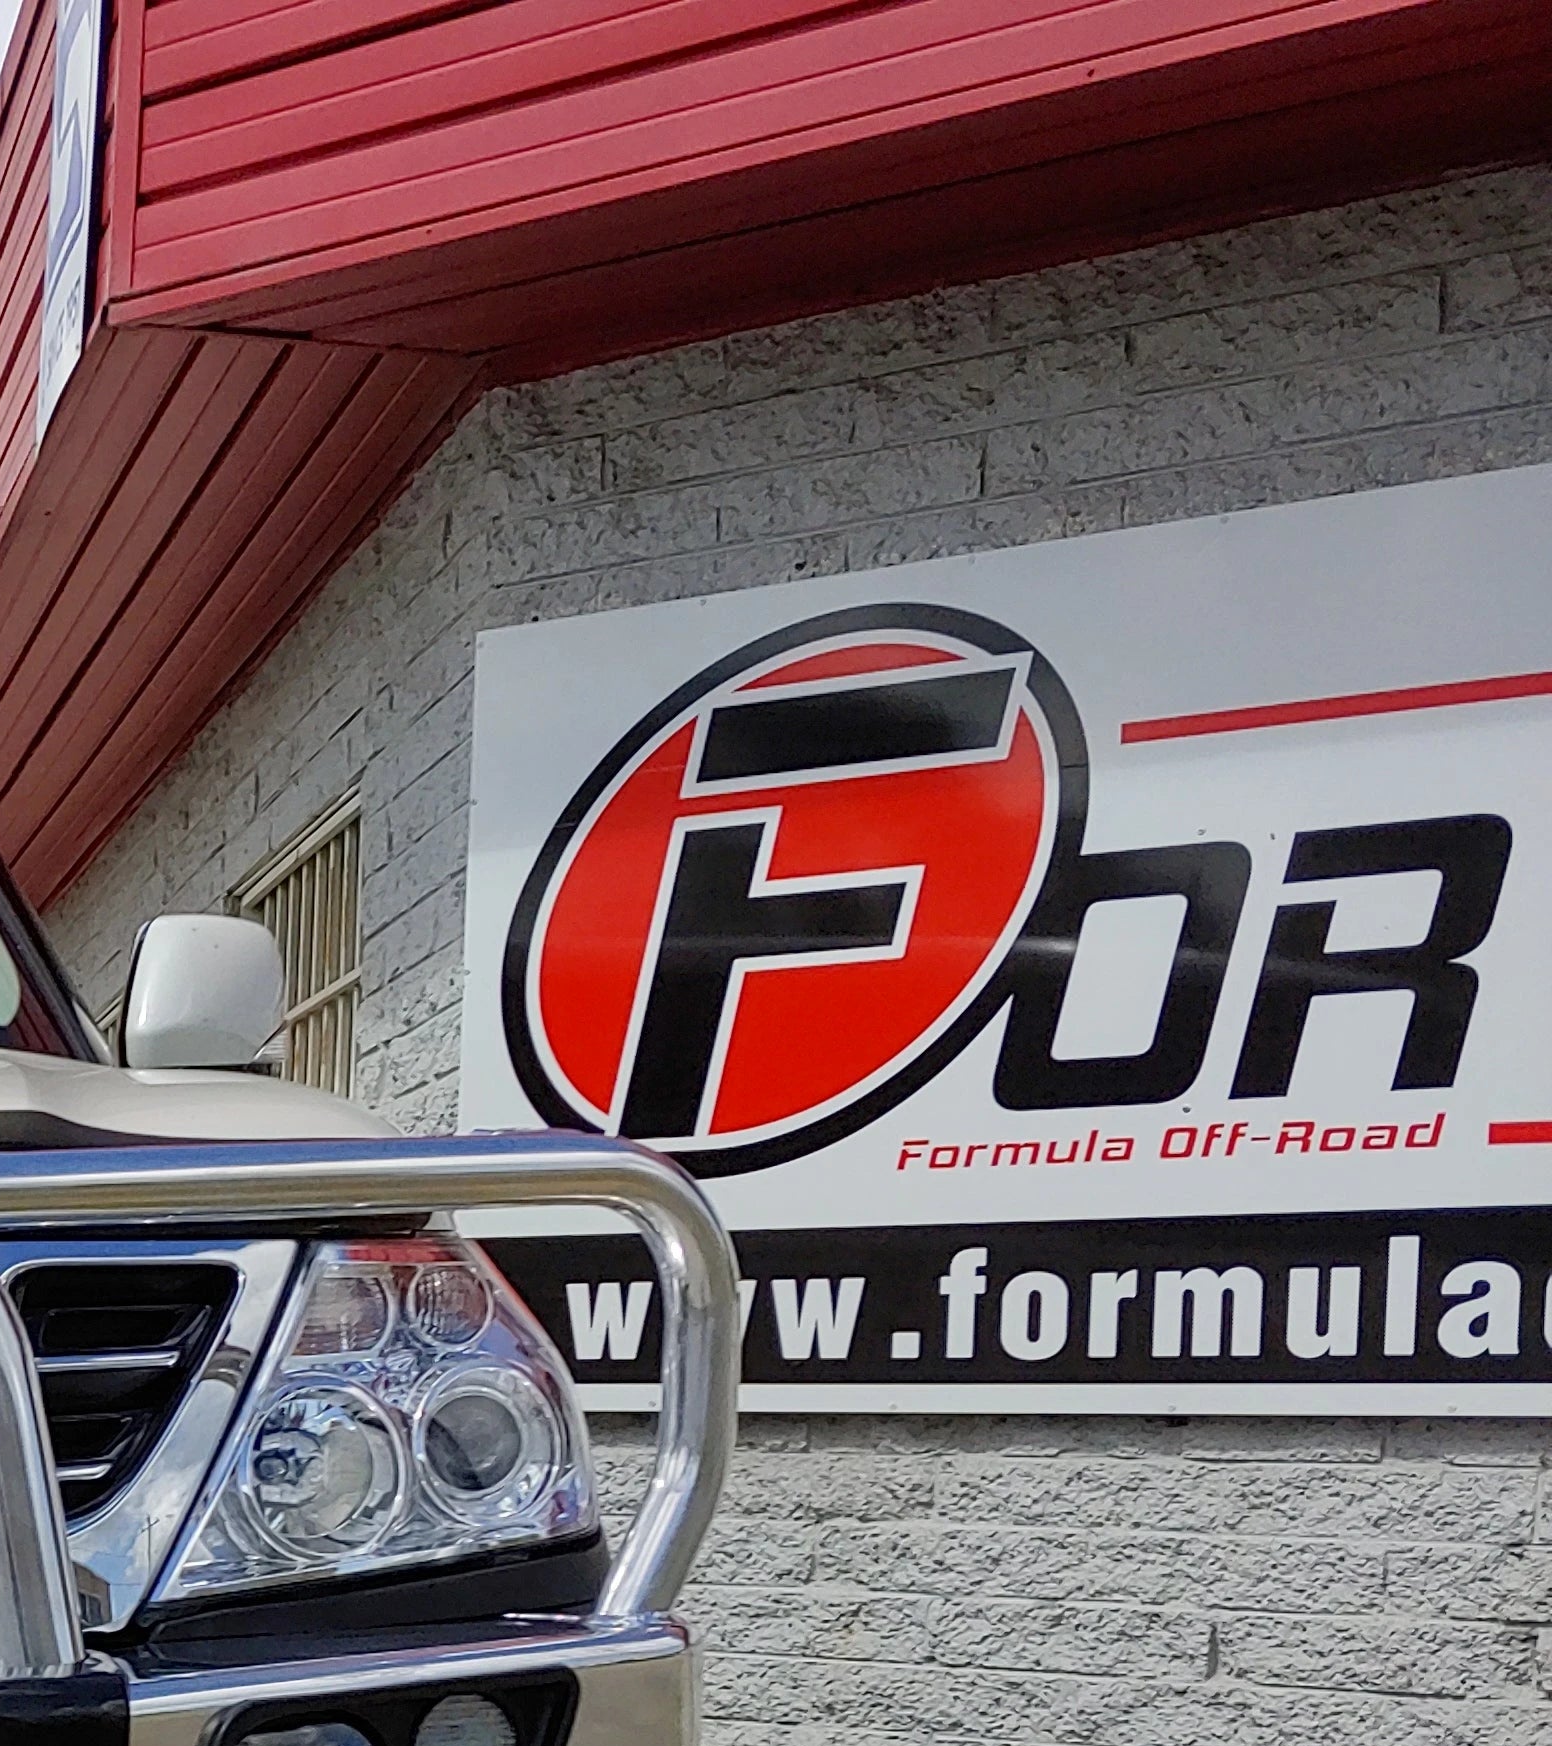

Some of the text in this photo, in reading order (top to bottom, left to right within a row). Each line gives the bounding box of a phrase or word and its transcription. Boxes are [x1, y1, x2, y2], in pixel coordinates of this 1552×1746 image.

[897, 1113, 1446, 1170] Formula Off-Road
[565, 1234, 1552, 1361] ww.formula
